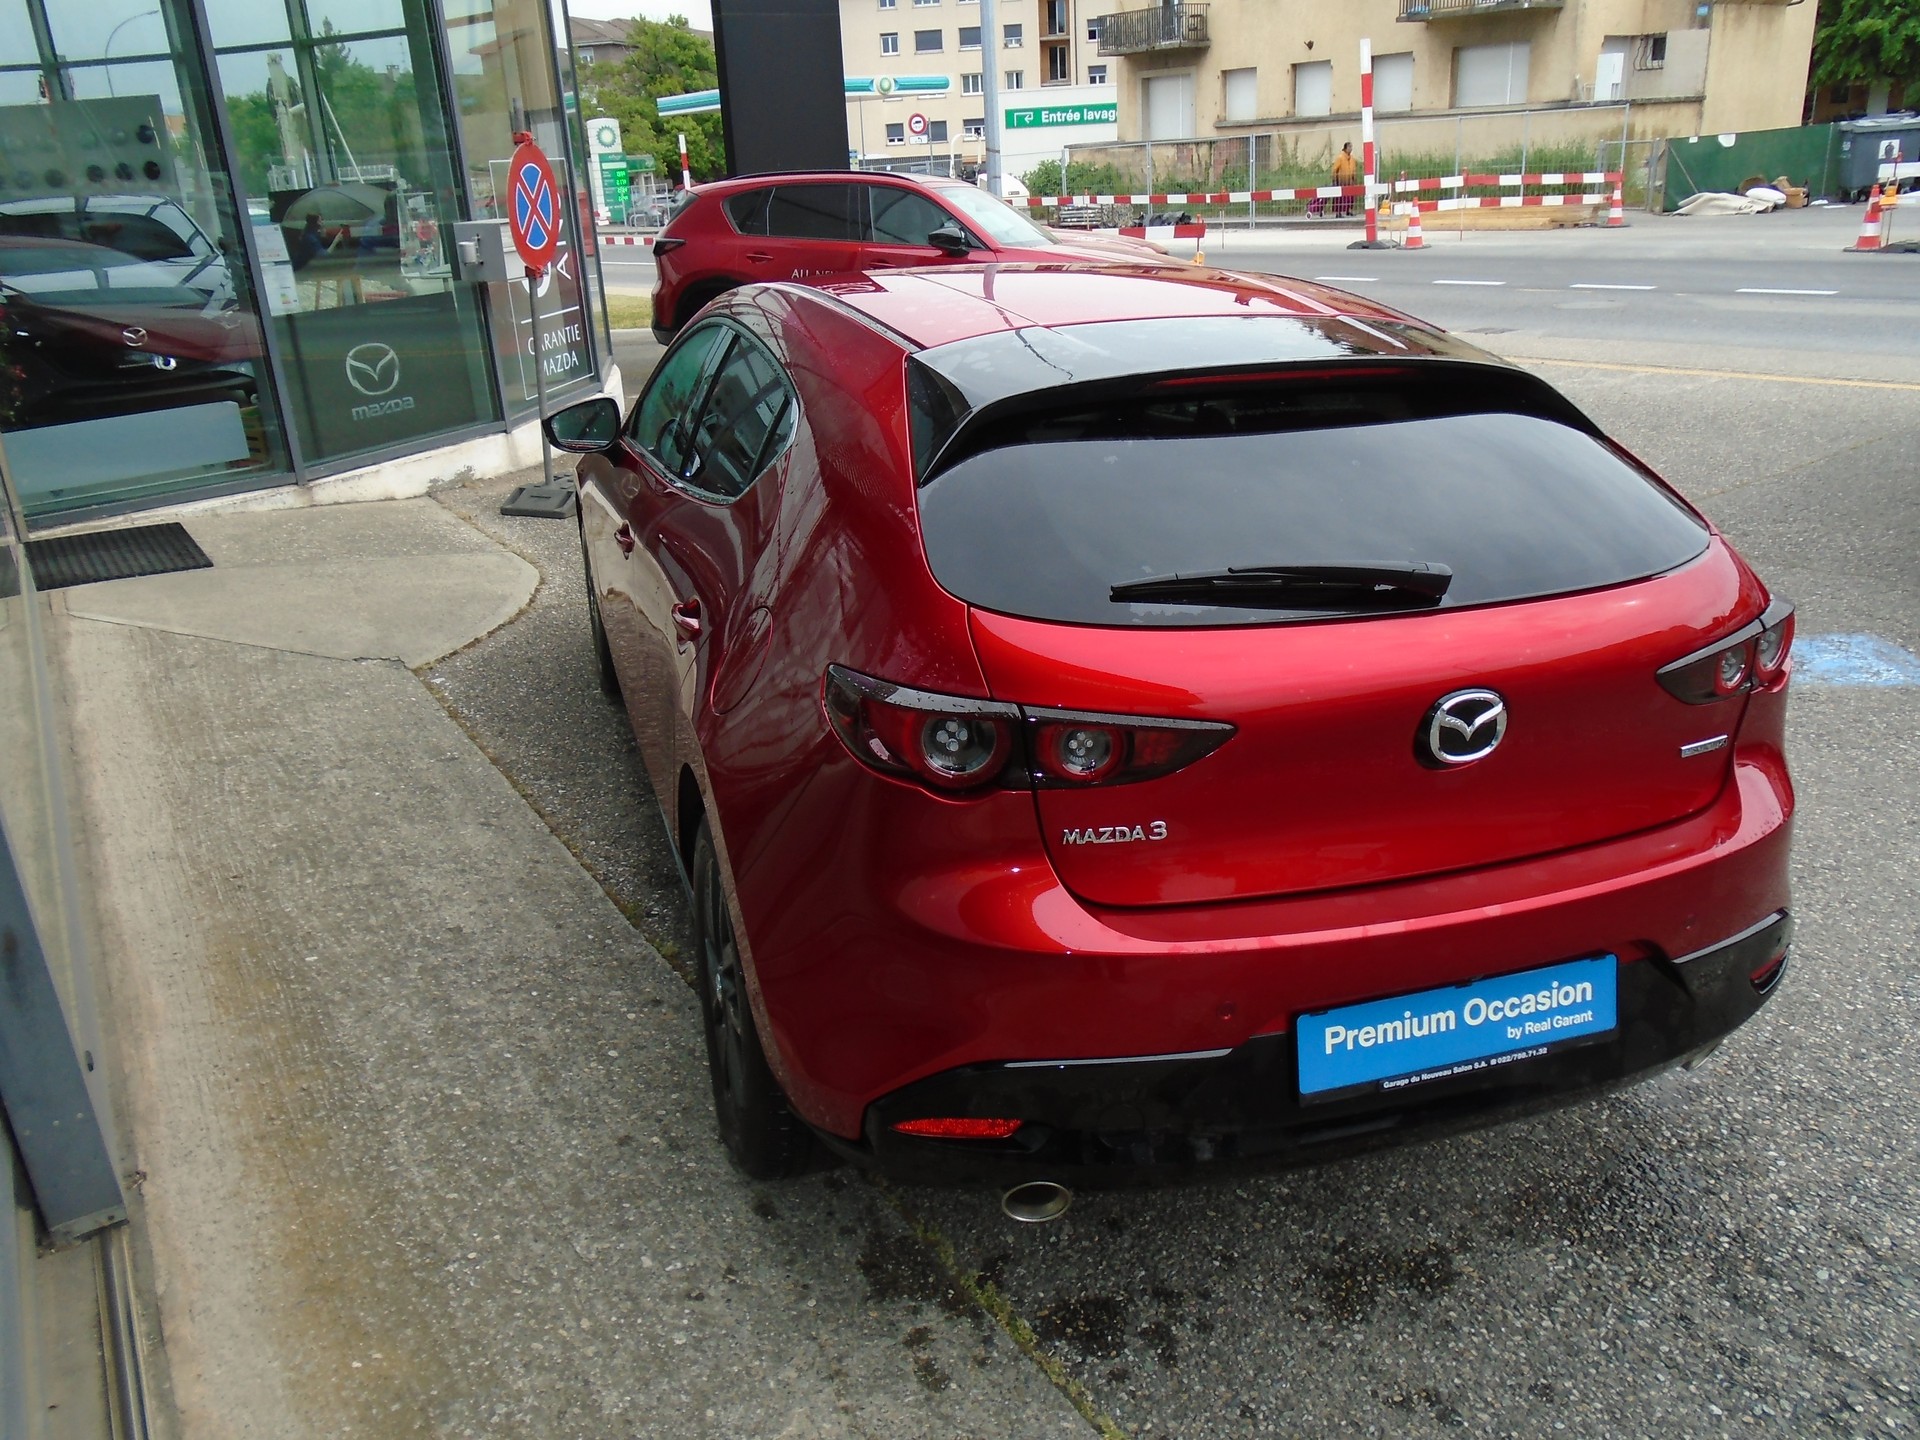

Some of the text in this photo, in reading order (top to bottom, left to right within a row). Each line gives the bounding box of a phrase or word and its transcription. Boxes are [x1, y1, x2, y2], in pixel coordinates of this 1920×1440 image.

[1041, 108, 1118, 123] Entrée lavag
[527, 324, 581, 356] GRANTIE
[351, 396, 415, 421] mazda
[1325, 980, 1592, 1054] Premium Occasion
[1507, 1010, 1593, 1040] by Real Garant
[1383, 1078, 1410, 1089] Garage
[1411, 1075, 1420, 1084] du
[1421, 1069, 1452, 1081] Nouveau
[1453, 1064, 1473, 1074] Salon
